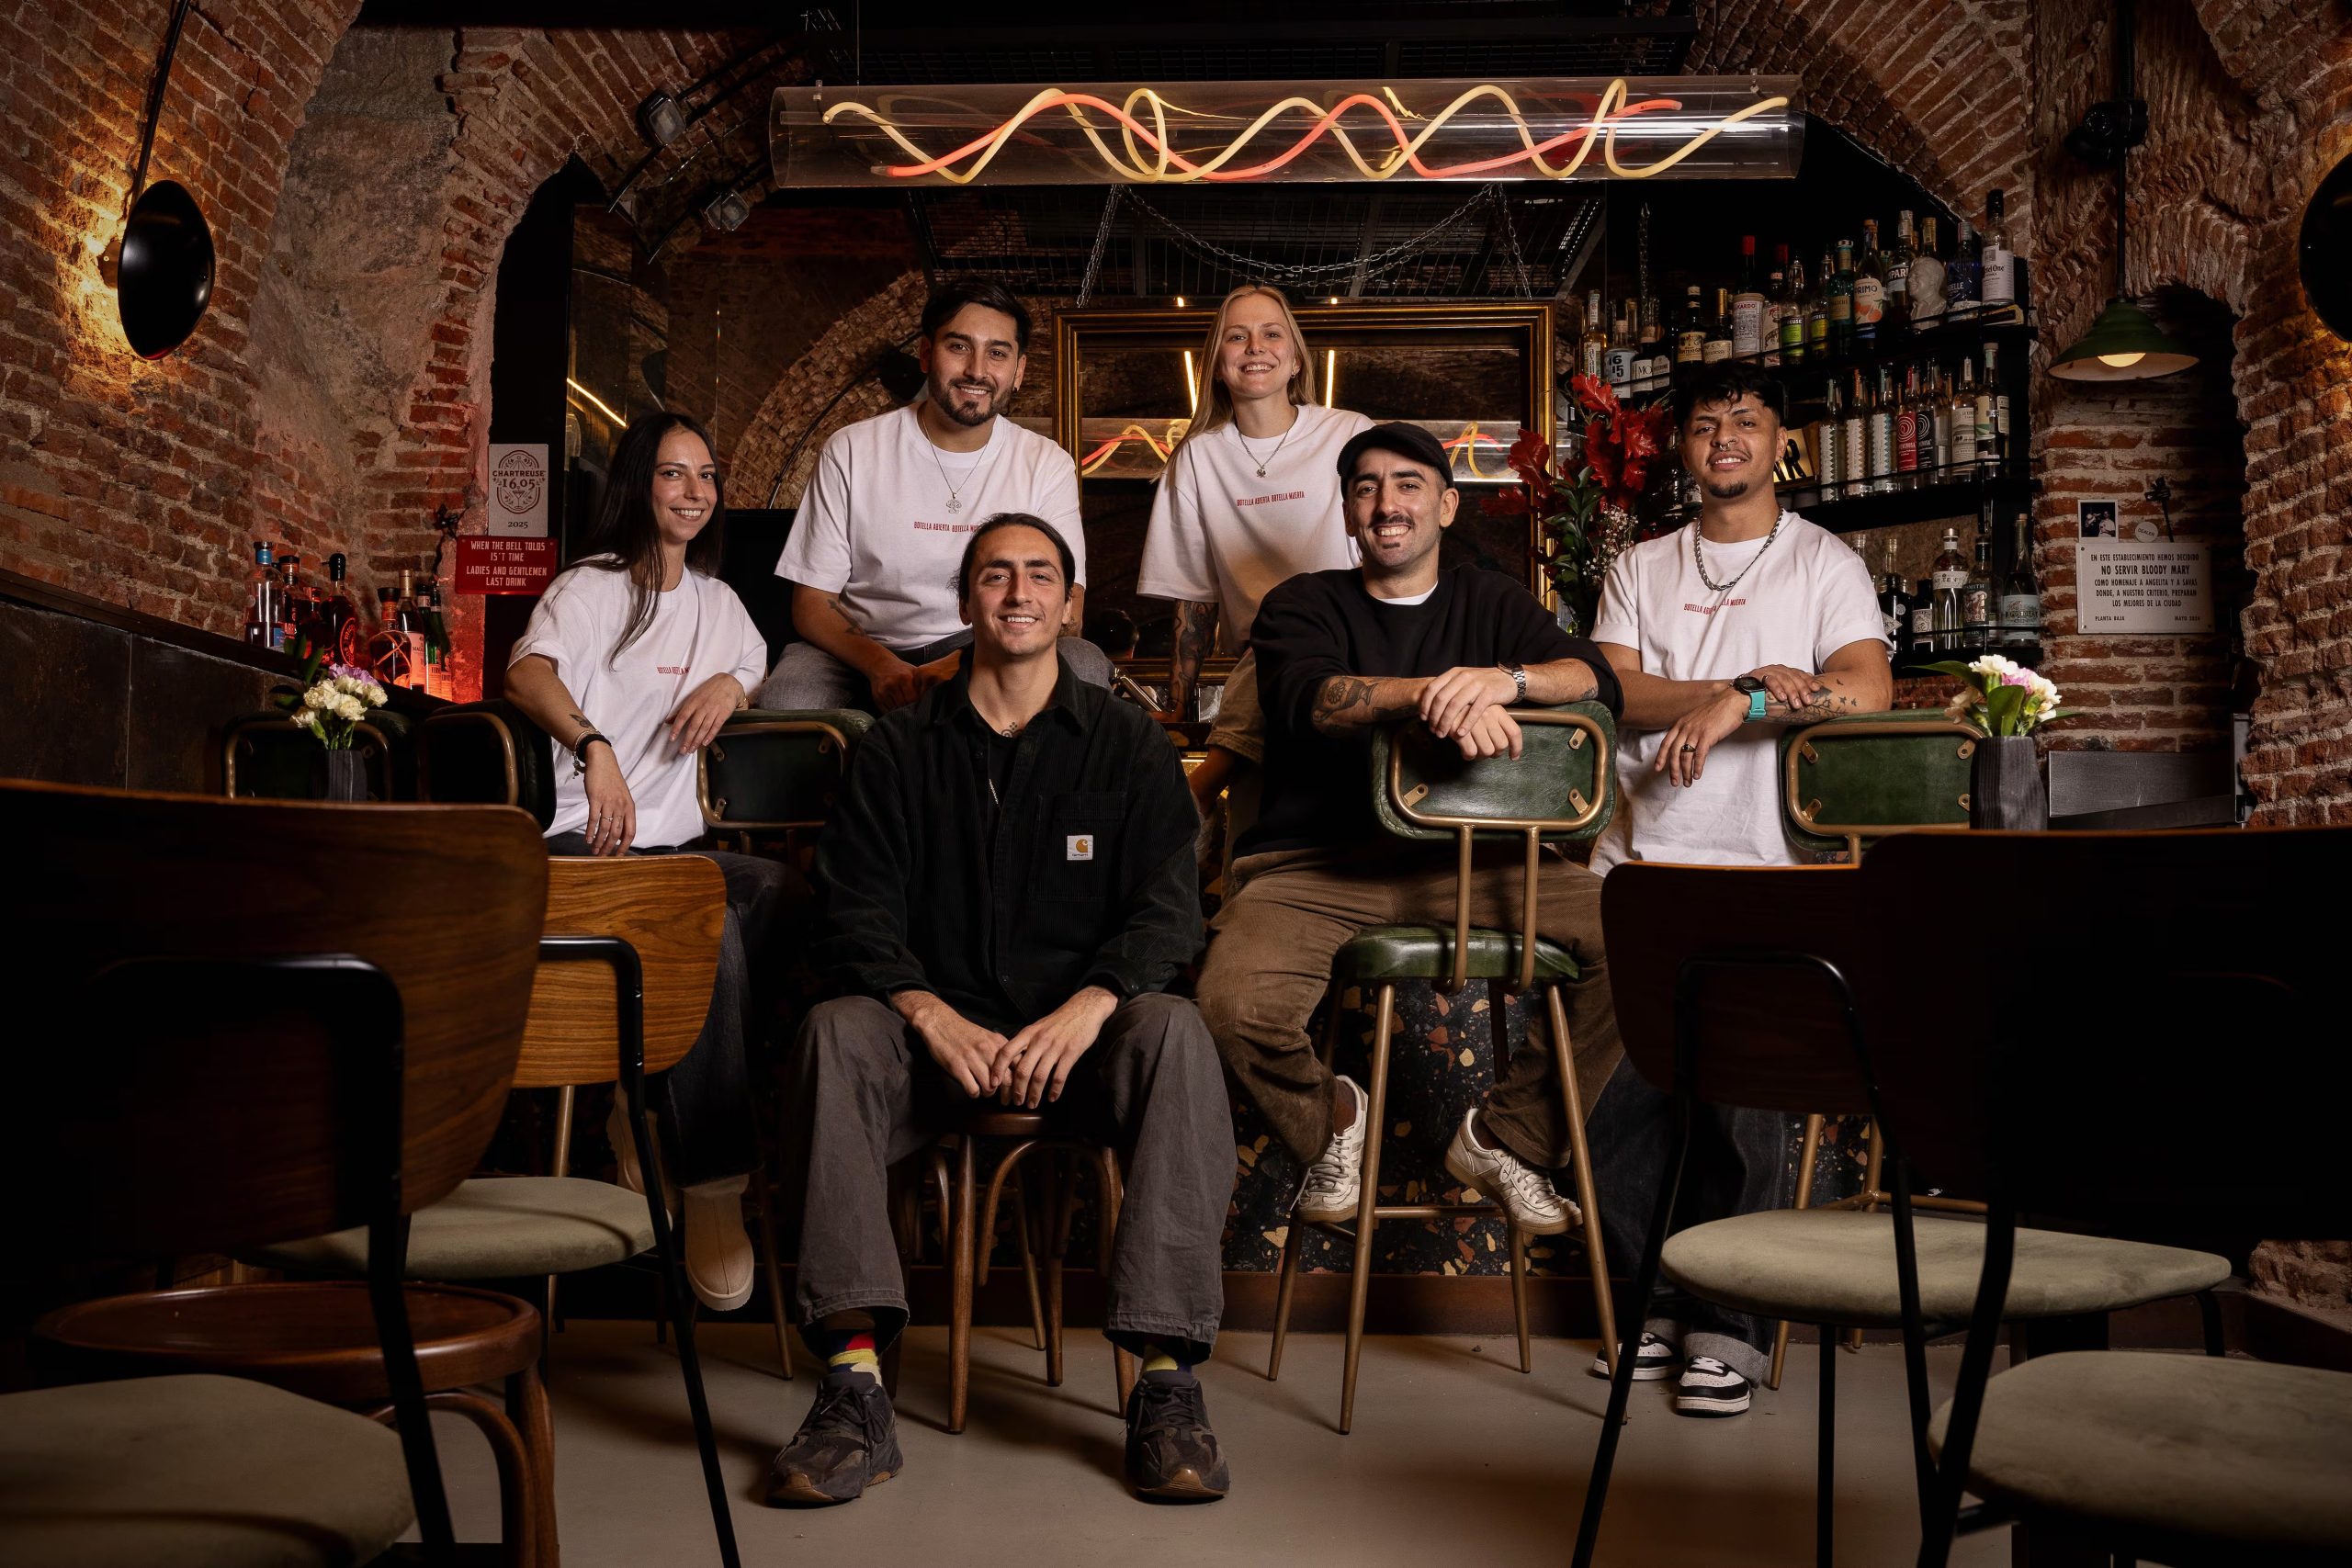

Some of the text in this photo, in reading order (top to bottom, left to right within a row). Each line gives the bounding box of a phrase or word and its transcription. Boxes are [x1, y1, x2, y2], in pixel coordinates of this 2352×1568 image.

[507, 521, 528, 529] 2025
[470, 540, 490, 550] WHEN
[492, 541, 504, 550] THE
[506, 541, 522, 550] BELL
[508, 552, 525, 562] TIME
[2113, 553, 2155, 561] ESTABLECIMIENTO
[2157, 553, 2175, 561] HEMOS
[2177, 553, 2199, 561] DECIDIDO
[466, 565, 548, 577] LADIES AND GENTLEMEN
[2101, 565, 2190, 575] NO SERVIR BLOODY MARY
[485, 577, 526, 587] LAST DRINK
[2094, 579, 2109, 587] COMO
[2111, 579, 2138, 587] HOMENAJE
[2122, 589, 2144, 597] NUESTRO
[2172, 589, 2197, 597] PREPARAN
[2155, 599, 2162, 607] LA
[2164, 599, 2182, 607] CIUDAD
